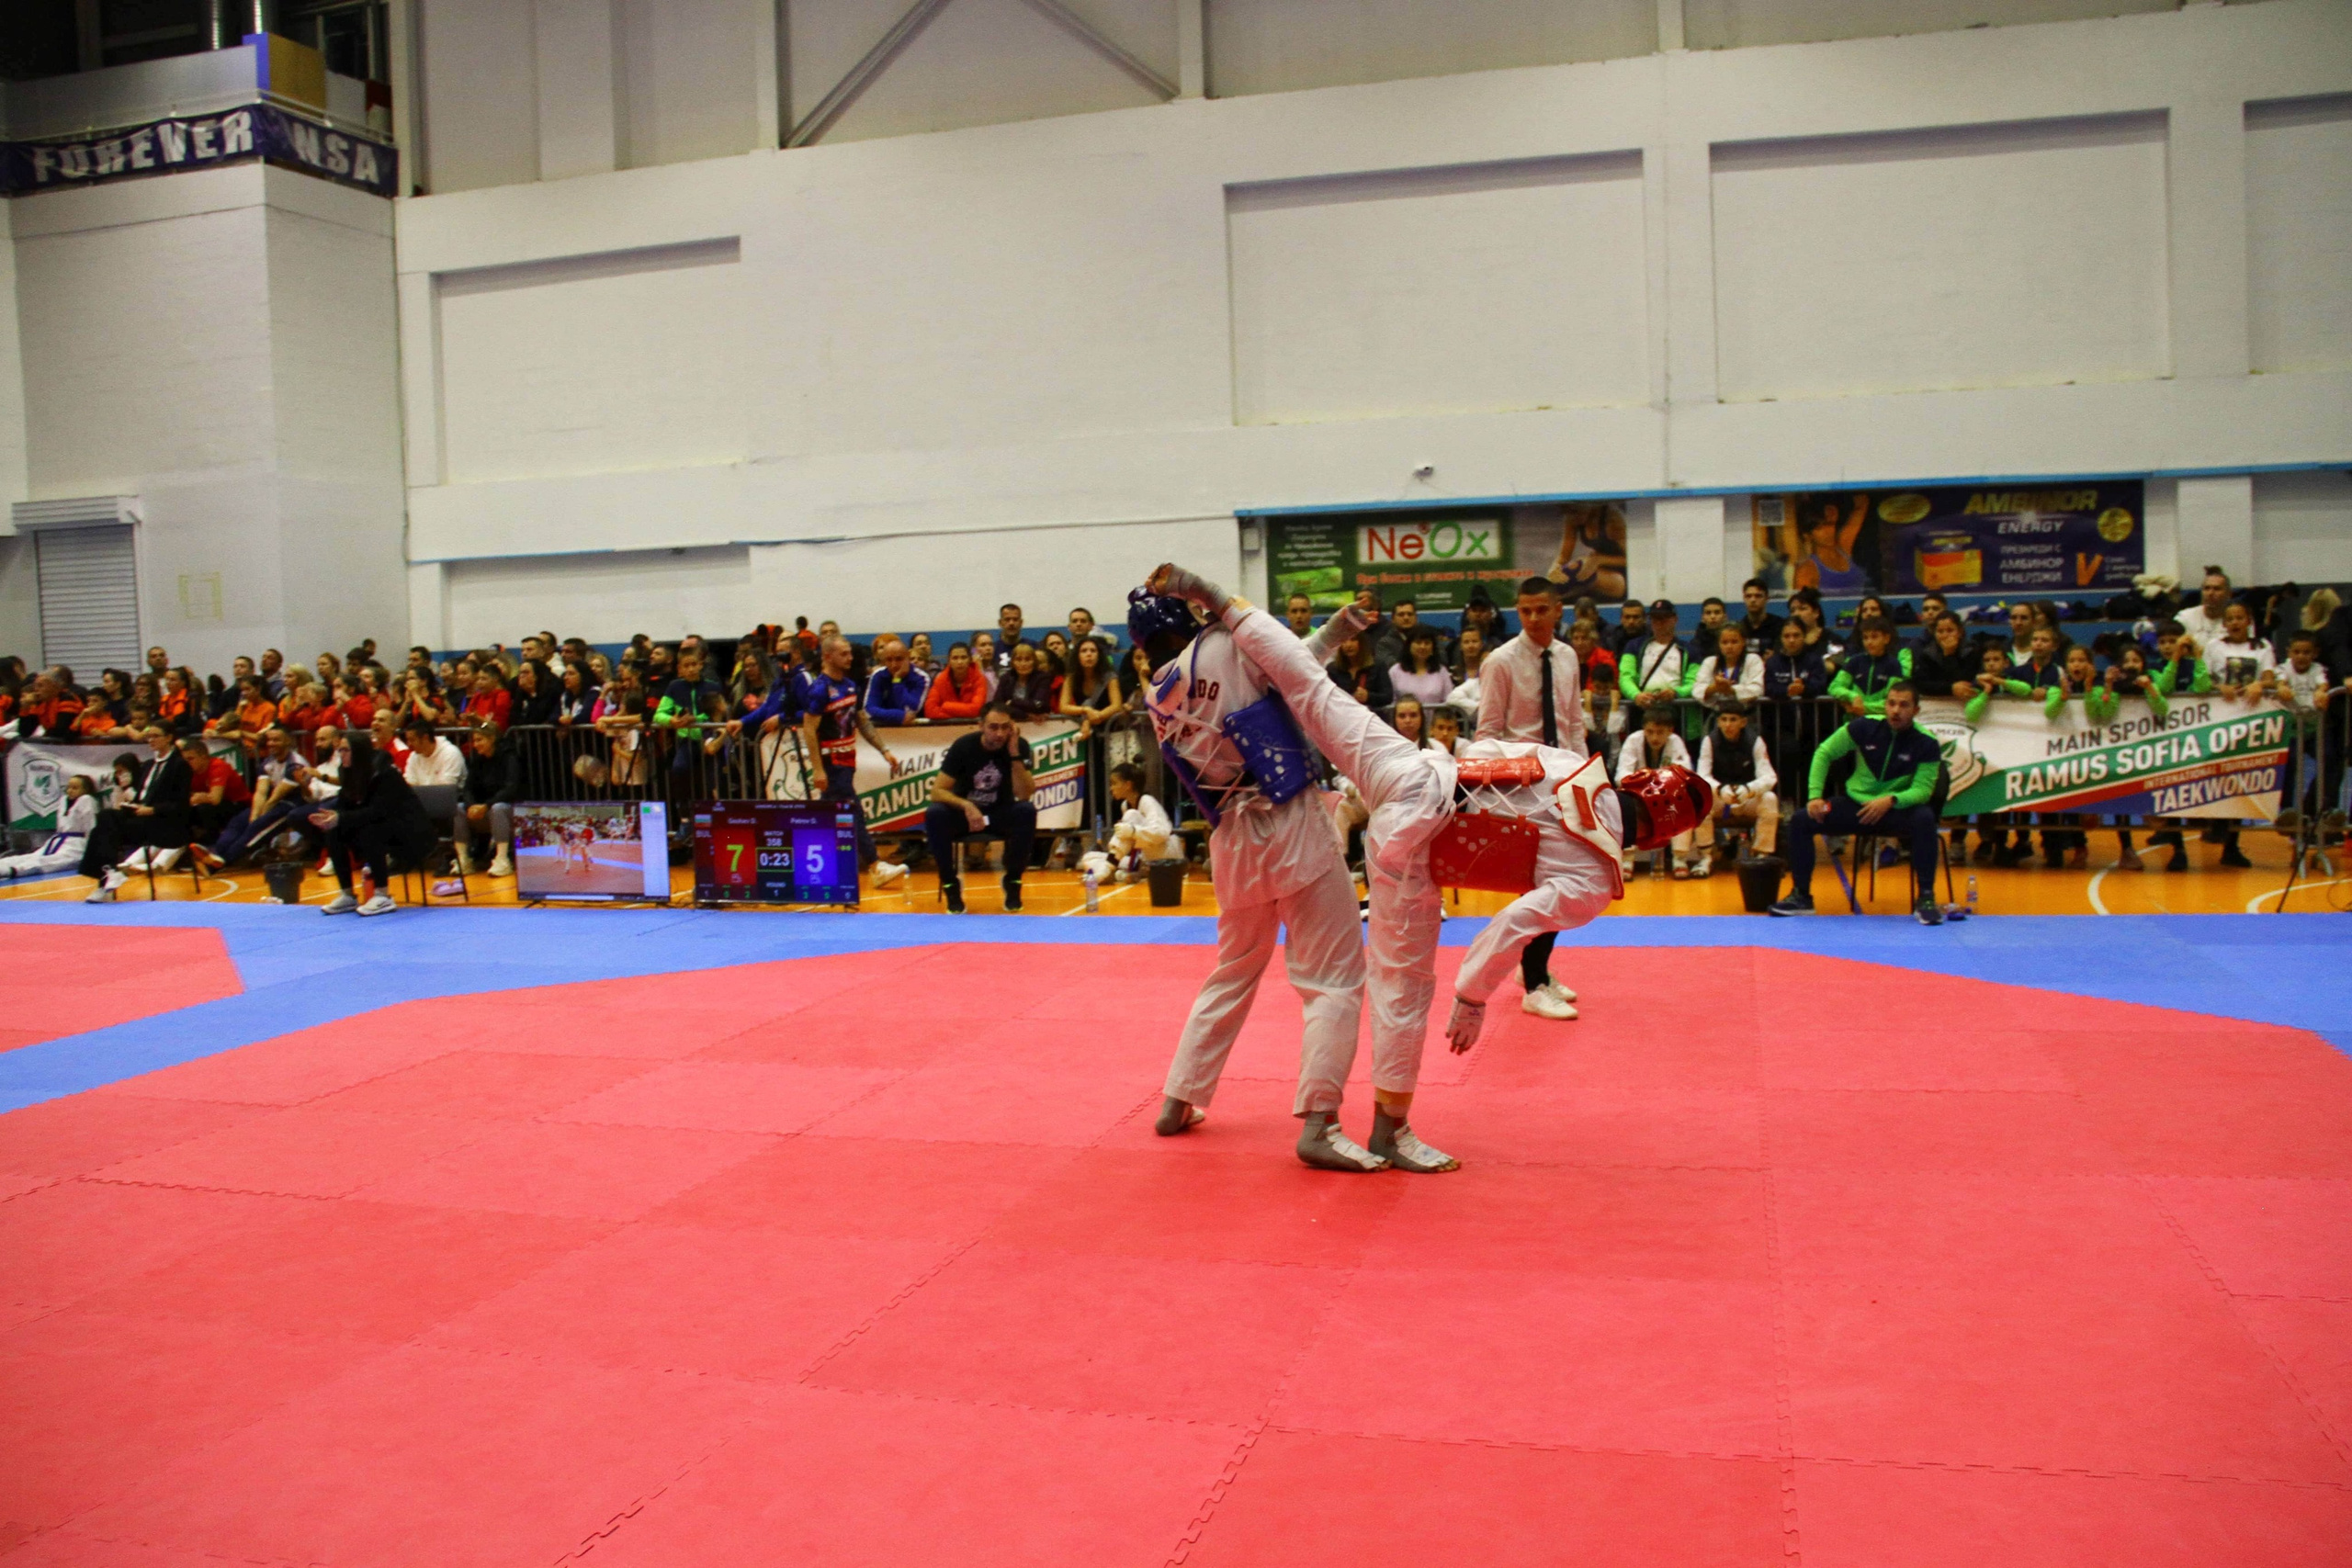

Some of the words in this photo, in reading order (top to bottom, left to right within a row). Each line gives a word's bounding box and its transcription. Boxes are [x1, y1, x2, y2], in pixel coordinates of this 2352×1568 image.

[32, 111, 254, 183] FOREVER
[291, 121, 380, 184] NSA
[1997, 521, 2064, 535] ENERGY
[2047, 728, 2101, 756] MAIN
[2109, 703, 2211, 743] SPONSOR
[1033, 738, 1078, 770] PEN
[2005, 758, 2109, 801] RAMUS
[2116, 727, 2201, 774] SOFIA
[2209, 715, 2285, 753] OPEN
[861, 776, 936, 819] RAMUS
[2152, 767, 2277, 813] TAEKWONDO
[726, 844, 744, 872] 7
[759, 852, 790, 866] 0:23
[806, 845, 824, 873] 5
